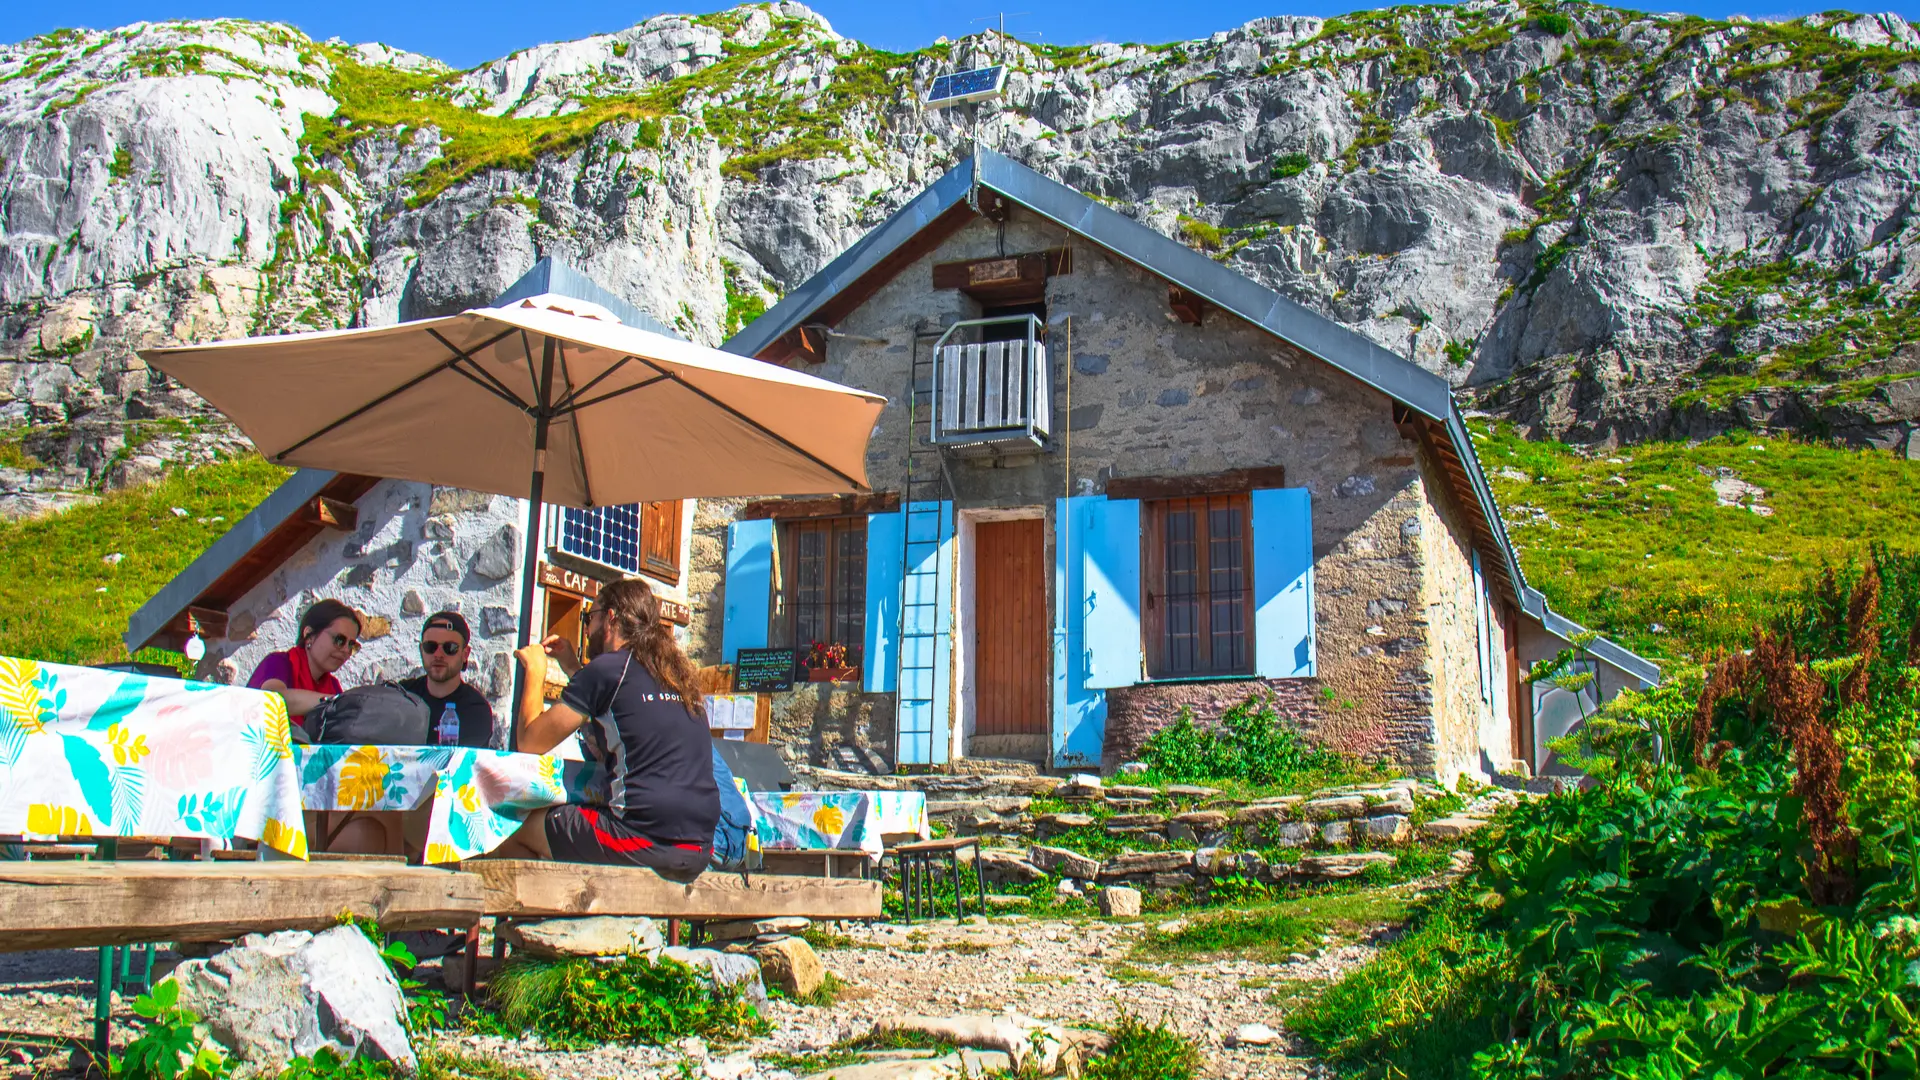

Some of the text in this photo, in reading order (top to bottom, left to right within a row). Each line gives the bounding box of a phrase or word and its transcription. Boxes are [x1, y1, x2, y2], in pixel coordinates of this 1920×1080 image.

[564, 570, 589, 592] CAF
[661, 600, 678, 618] ATE
[641, 693, 654, 702] le
